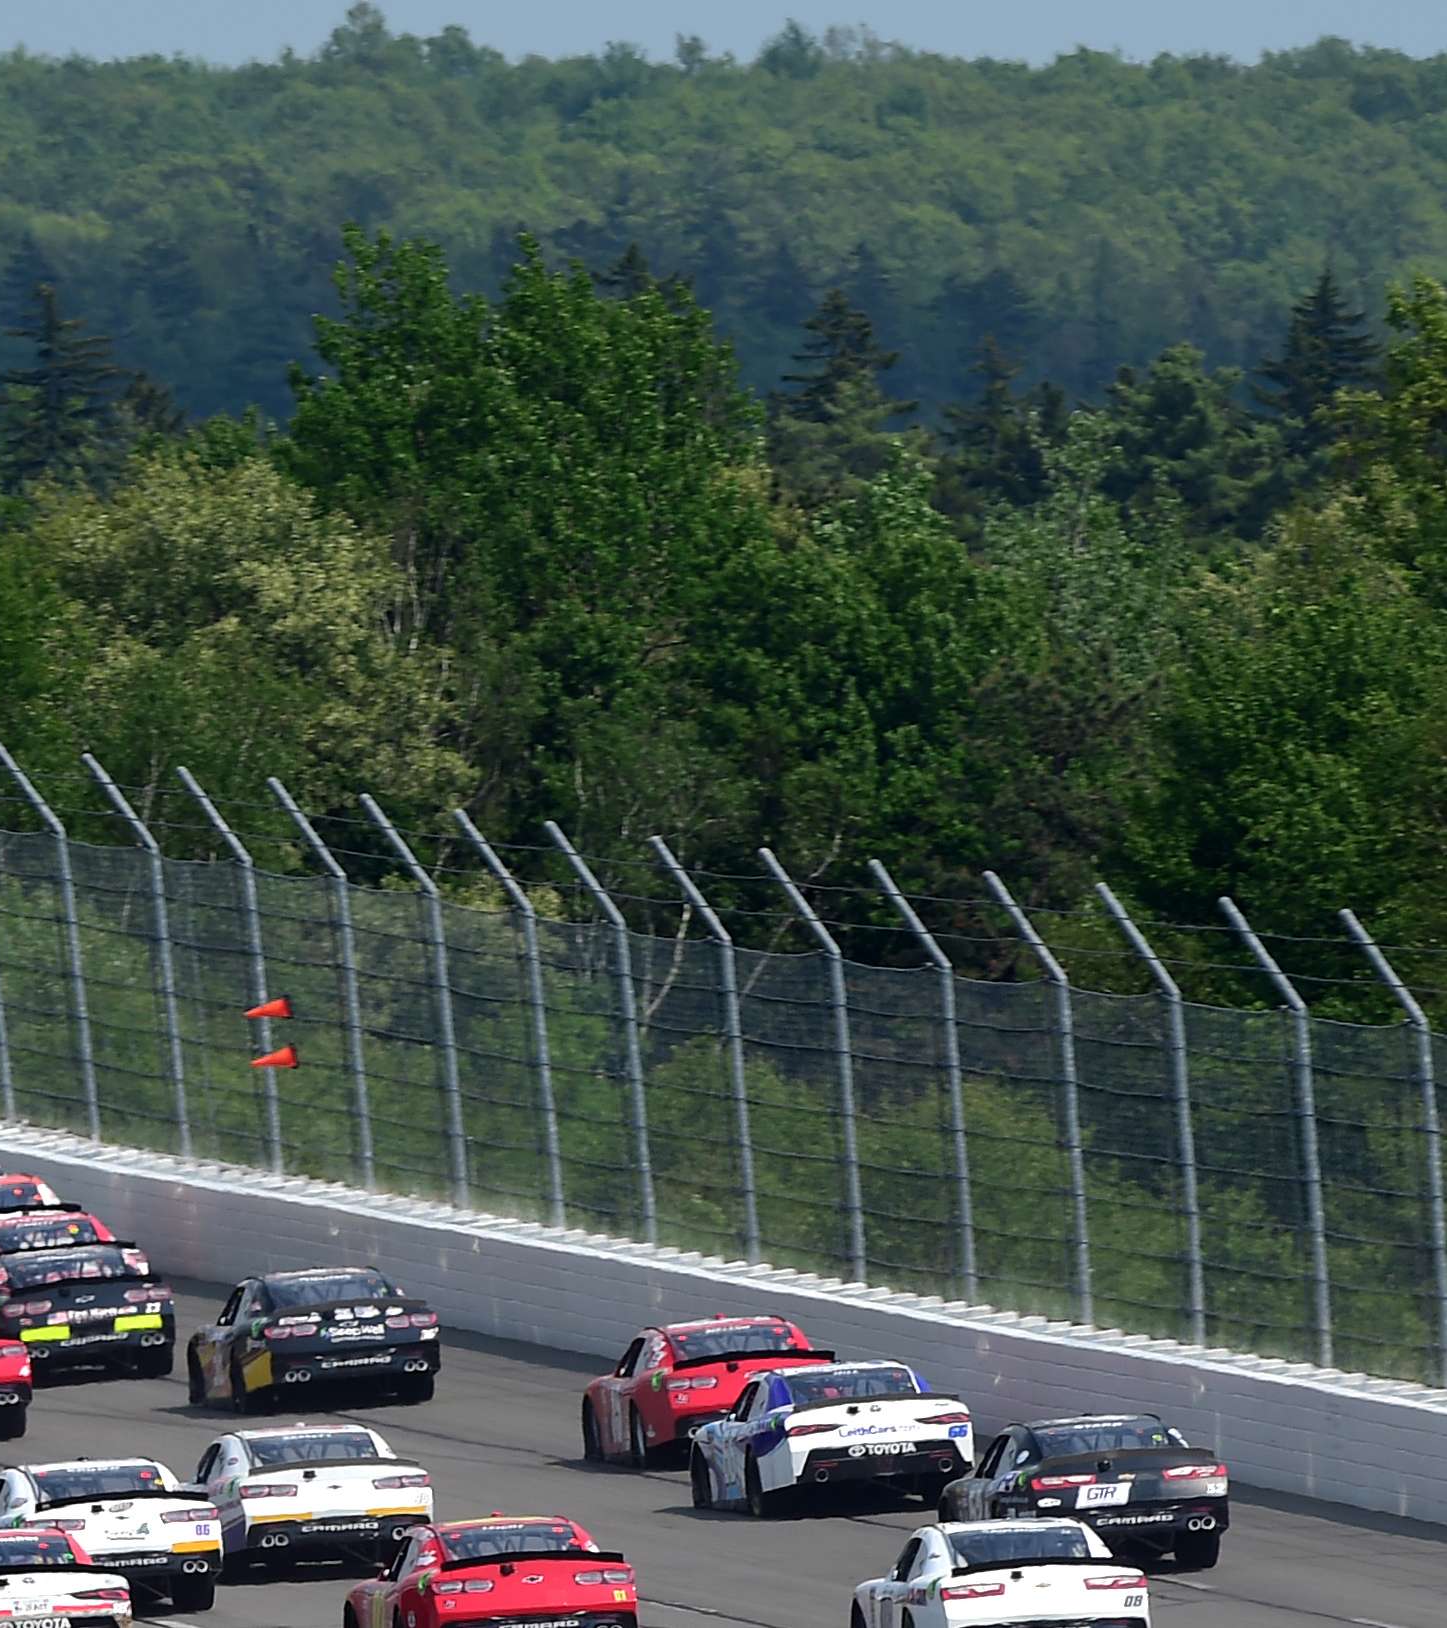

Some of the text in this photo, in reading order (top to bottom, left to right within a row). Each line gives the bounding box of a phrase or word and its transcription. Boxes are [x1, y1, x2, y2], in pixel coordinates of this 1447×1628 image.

[866, 1442, 917, 1455] TOYOTA
[301, 1521, 379, 1533] CAMARO
[1123, 1595, 1143, 1607] 08
[14, 1617, 71, 1628] TOYOTA
